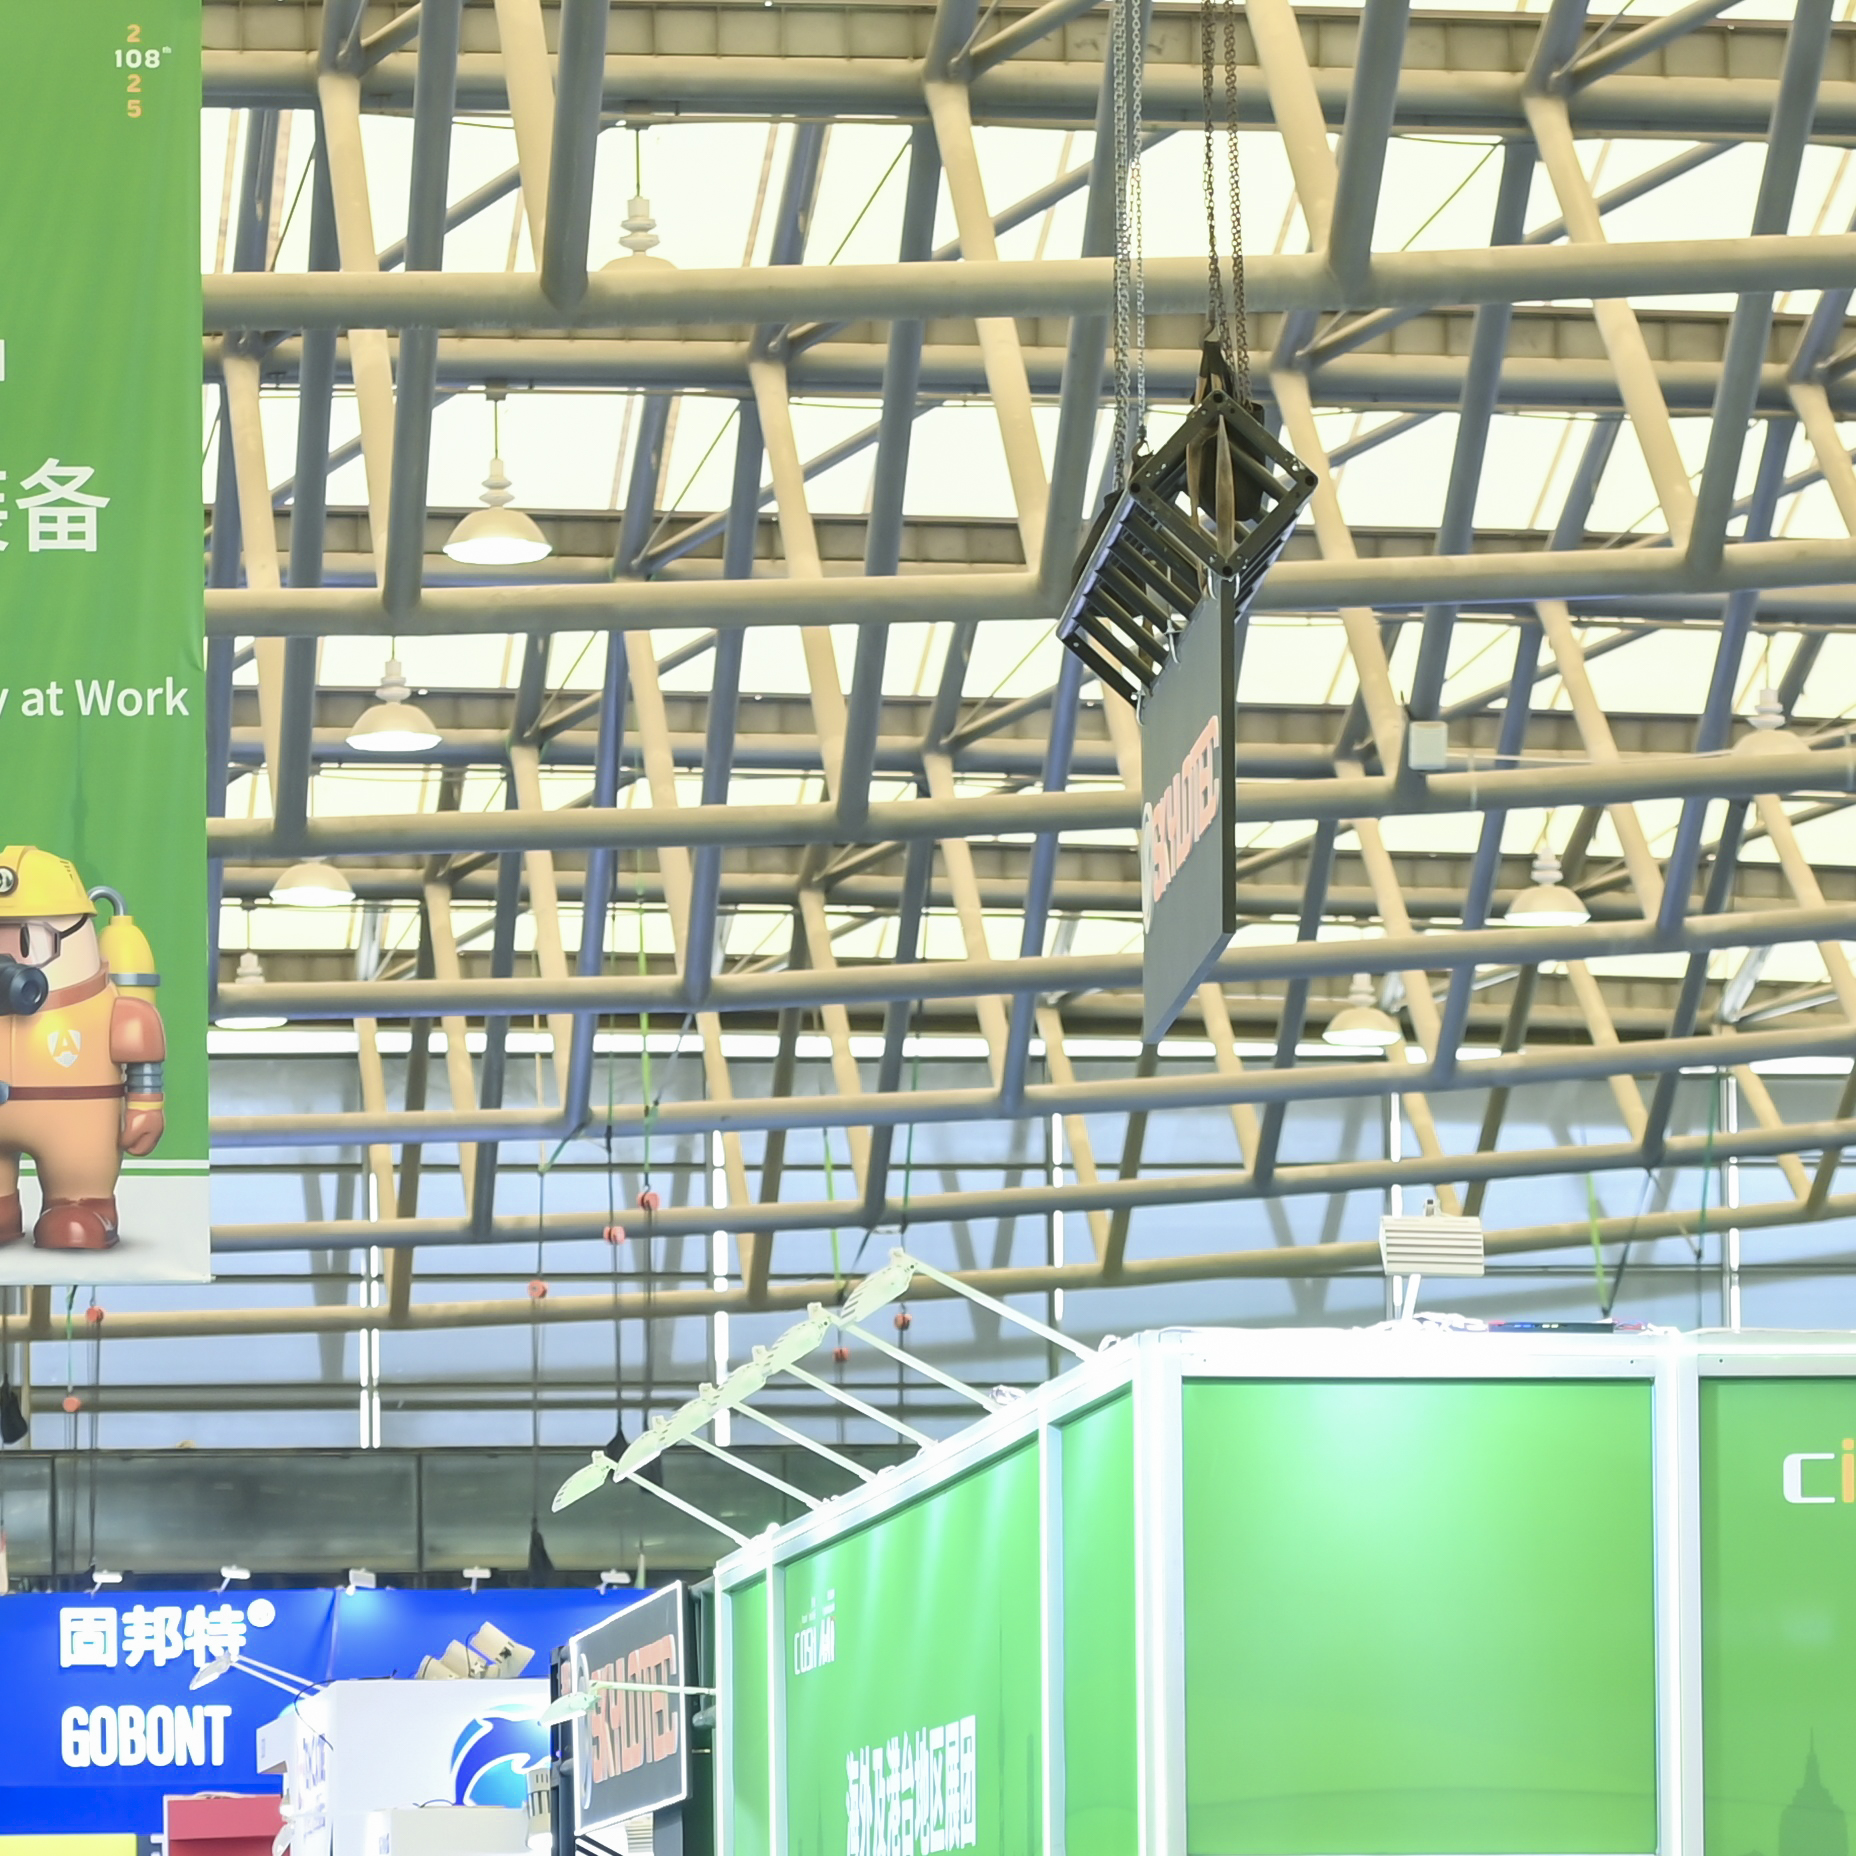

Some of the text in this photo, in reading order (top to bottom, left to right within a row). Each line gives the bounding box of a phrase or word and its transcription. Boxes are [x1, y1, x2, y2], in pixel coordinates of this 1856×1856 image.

[21, 681, 64, 718] at
[75, 676, 190, 718] Work
[59, 1604, 247, 1671] 固邦特
[60, 1704, 233, 1769] GOBONT
[590, 1634, 679, 1784] SKYLOTEC
